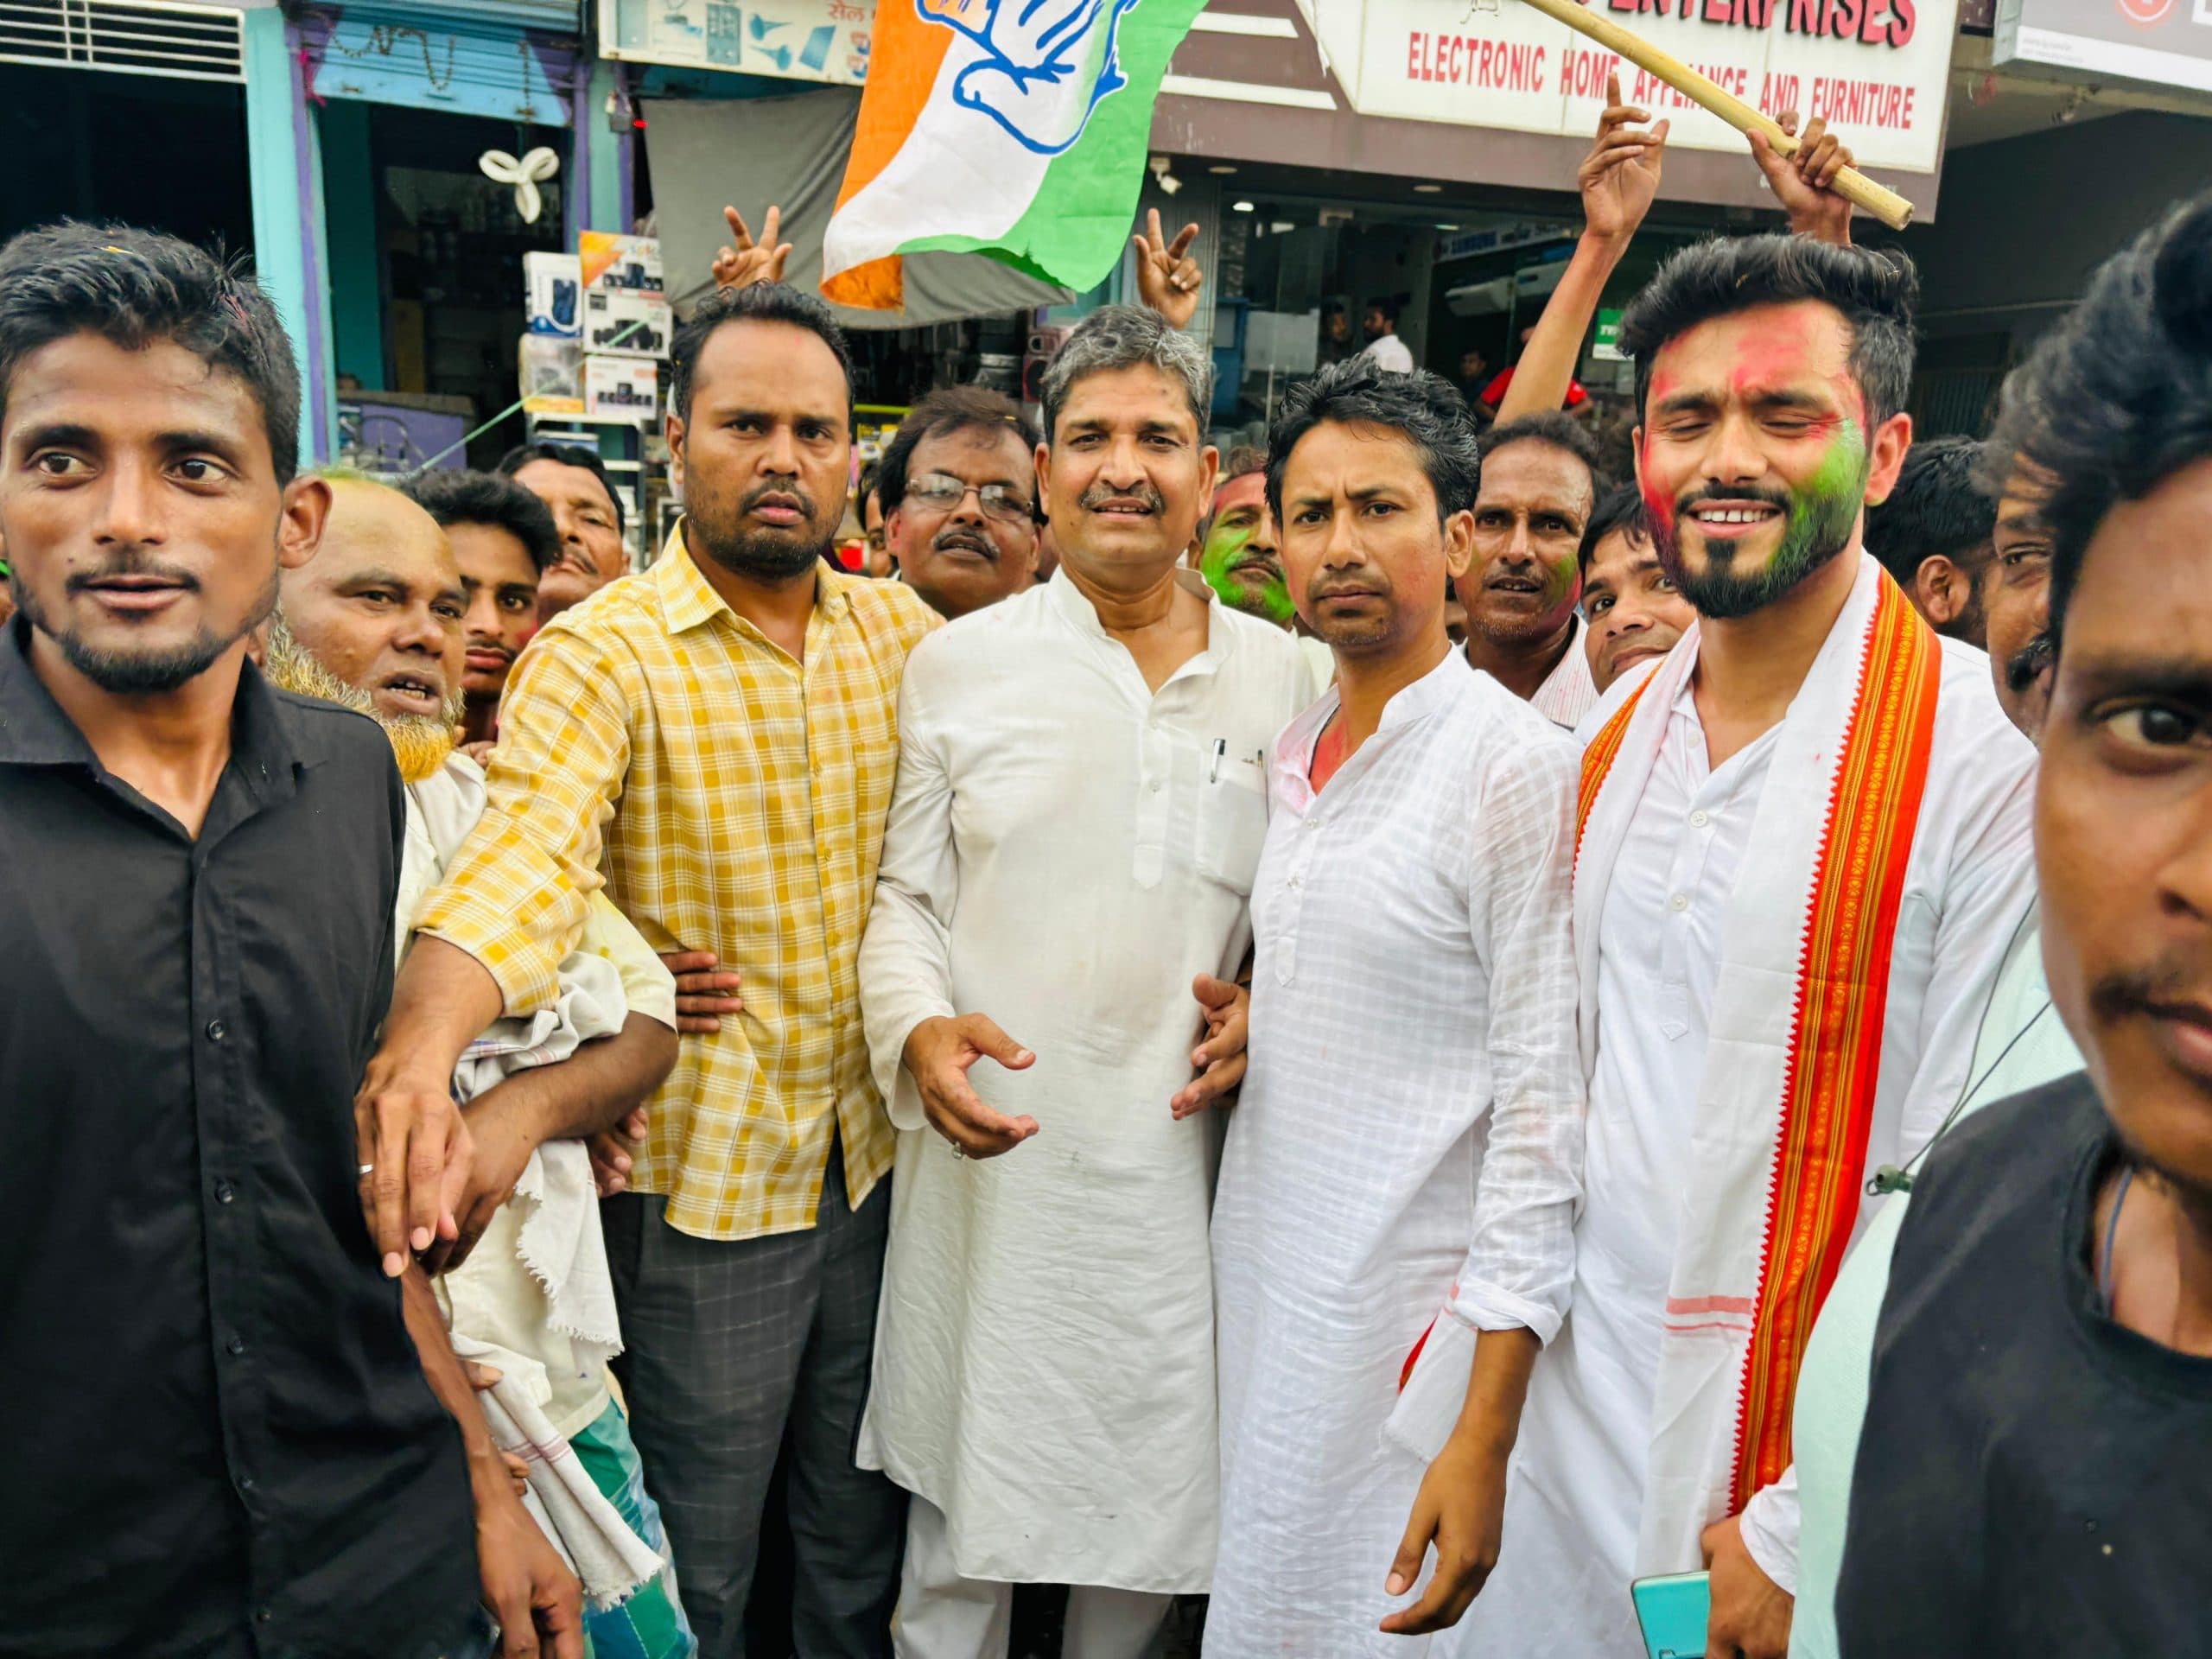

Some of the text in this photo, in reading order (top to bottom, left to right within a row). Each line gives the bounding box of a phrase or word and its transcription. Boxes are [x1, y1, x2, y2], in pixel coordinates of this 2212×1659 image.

[1408, 31, 1545, 92] ELECTRONIC
[1632, 63, 1746, 109] APPLE
[1759, 72, 1799, 118] AND
[1811, 77, 1915, 130] FURNITURE
